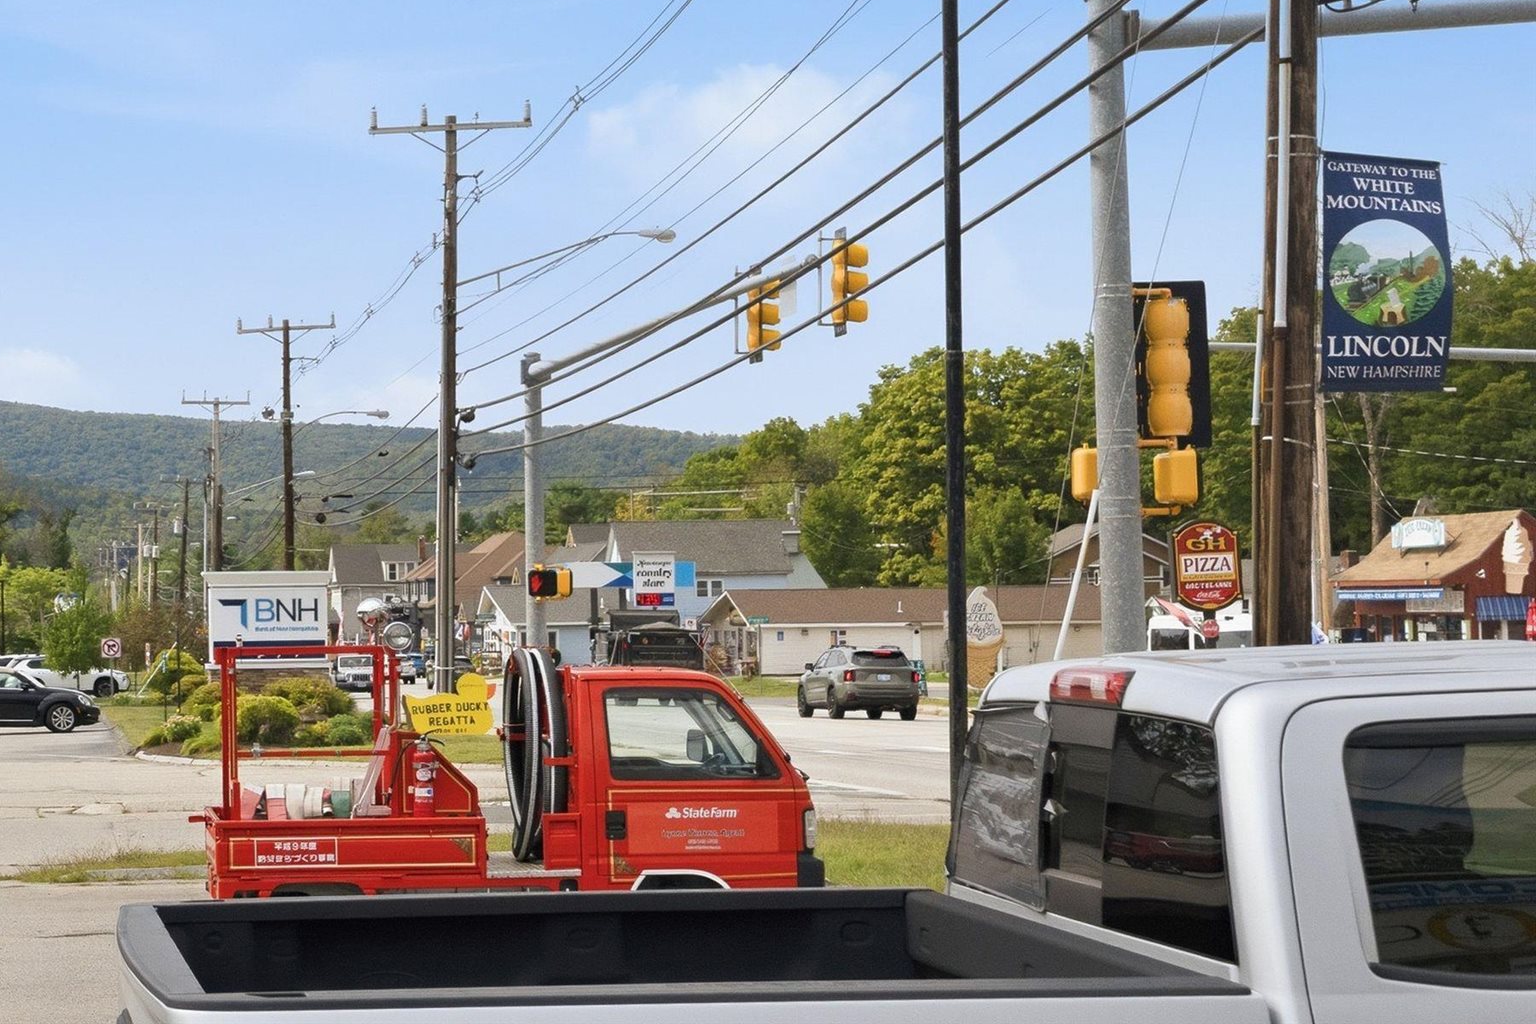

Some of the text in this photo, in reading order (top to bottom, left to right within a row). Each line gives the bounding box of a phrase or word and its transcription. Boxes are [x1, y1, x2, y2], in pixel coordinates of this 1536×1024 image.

[1327, 161, 1437, 180] GATEWAY TO THE
[1353, 177, 1415, 195] WHITE
[1326, 195, 1442, 215] MOUNTAINS
[1327, 335, 1447, 357] LINCOLN
[1327, 365, 1441, 378] NEW HAMPSHIRE
[1185, 537, 1226, 551] GH
[1183, 557, 1232, 573] PIZZA
[255, 598, 318, 622] BNH
[412, 701, 489, 715] RUBBER DUCKY
[429, 716, 476, 726] REGATTA
